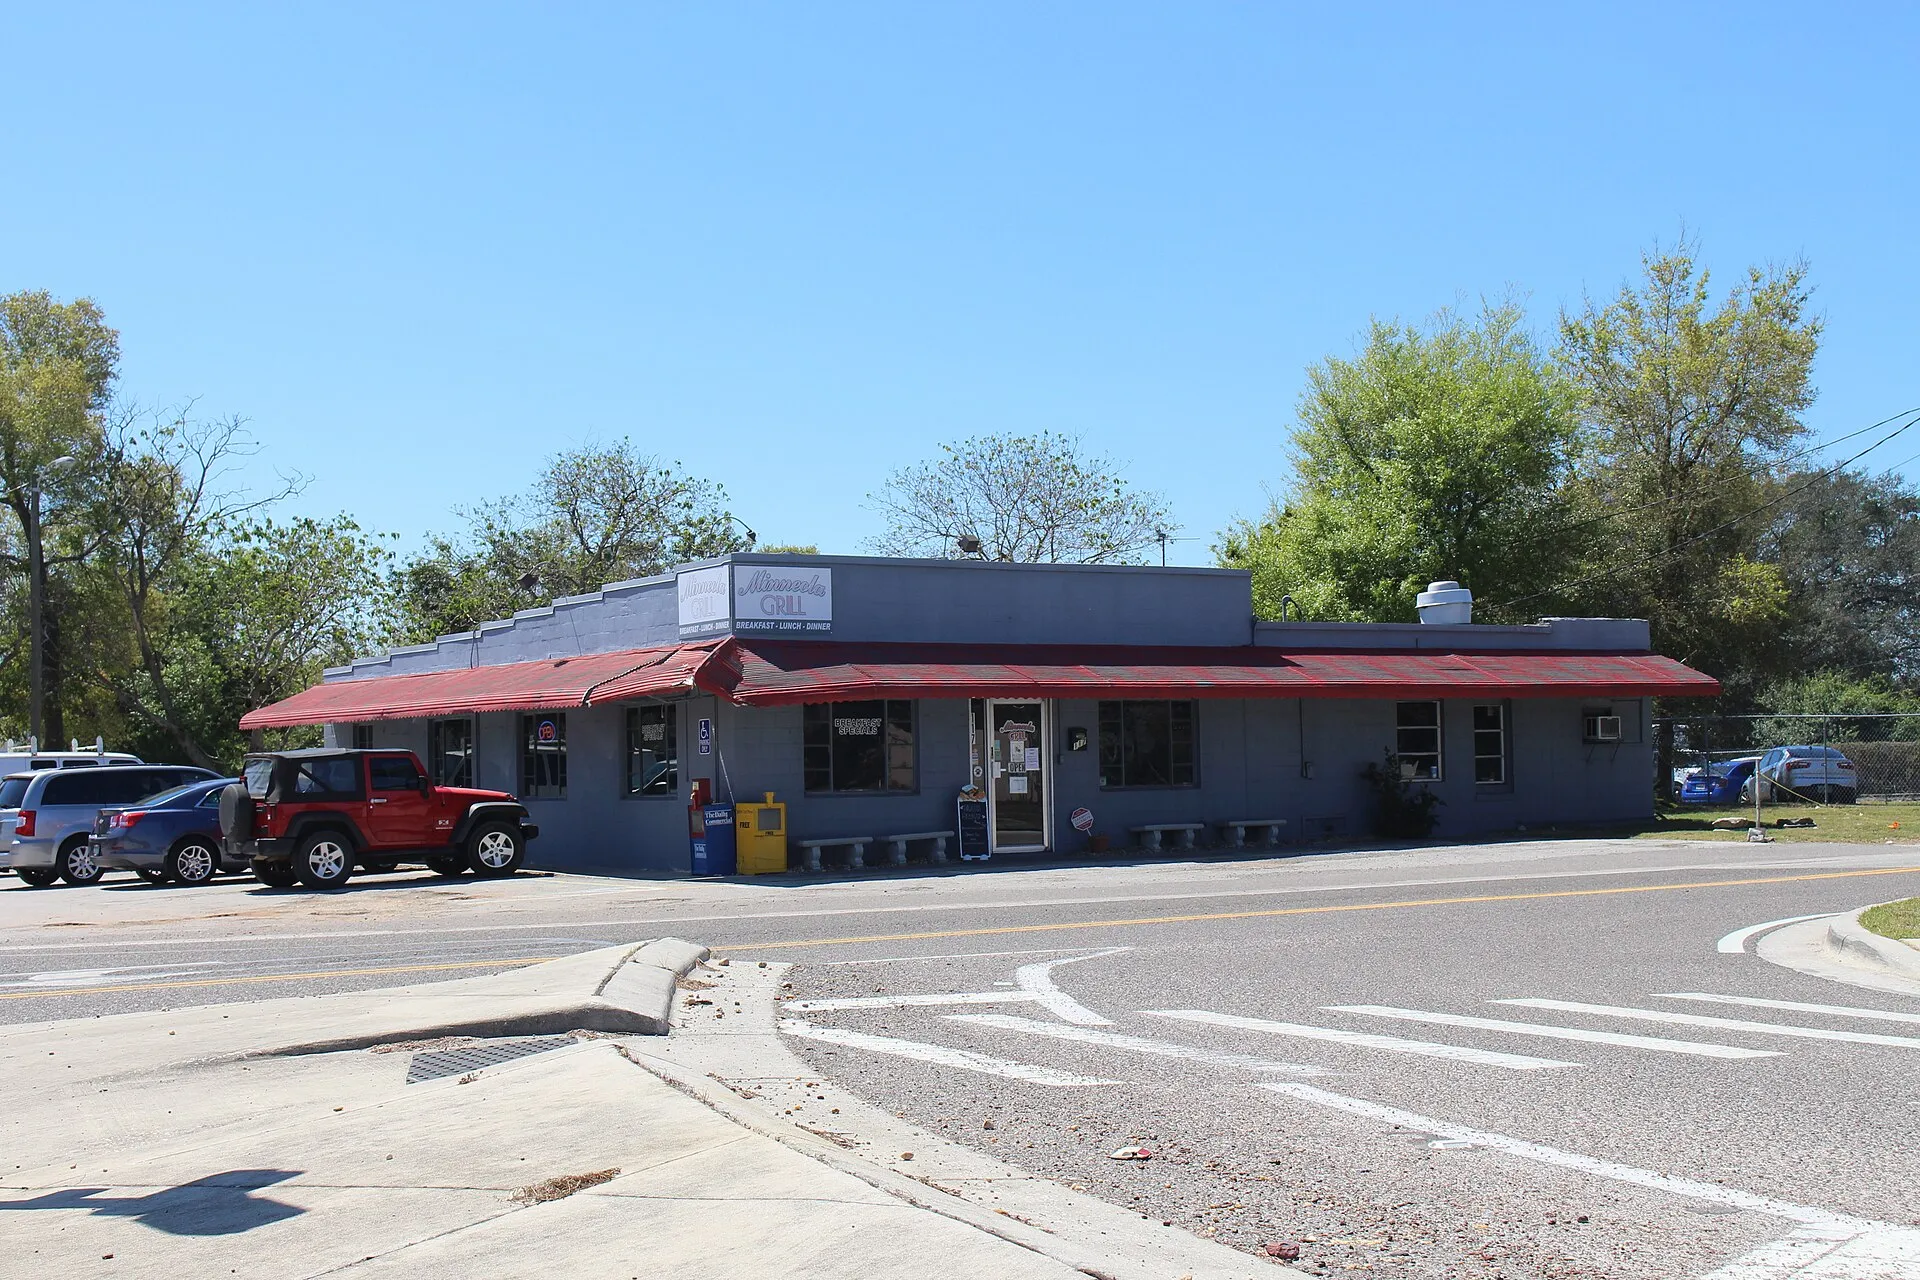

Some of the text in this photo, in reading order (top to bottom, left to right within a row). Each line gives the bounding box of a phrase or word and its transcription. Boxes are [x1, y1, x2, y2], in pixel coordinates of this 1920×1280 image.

[738, 570, 826, 597] Minneola
[759, 594, 806, 616] GRILL
[679, 620, 730, 635] BREAKFAST LUNCH DINNER
[735, 621, 831, 631] BREAKFAST LUNCH DINNER
[835, 718, 881, 727] BREAKFAST
[839, 727, 878, 735] SPECIALS
[1009, 763, 1026, 773] OPEN
